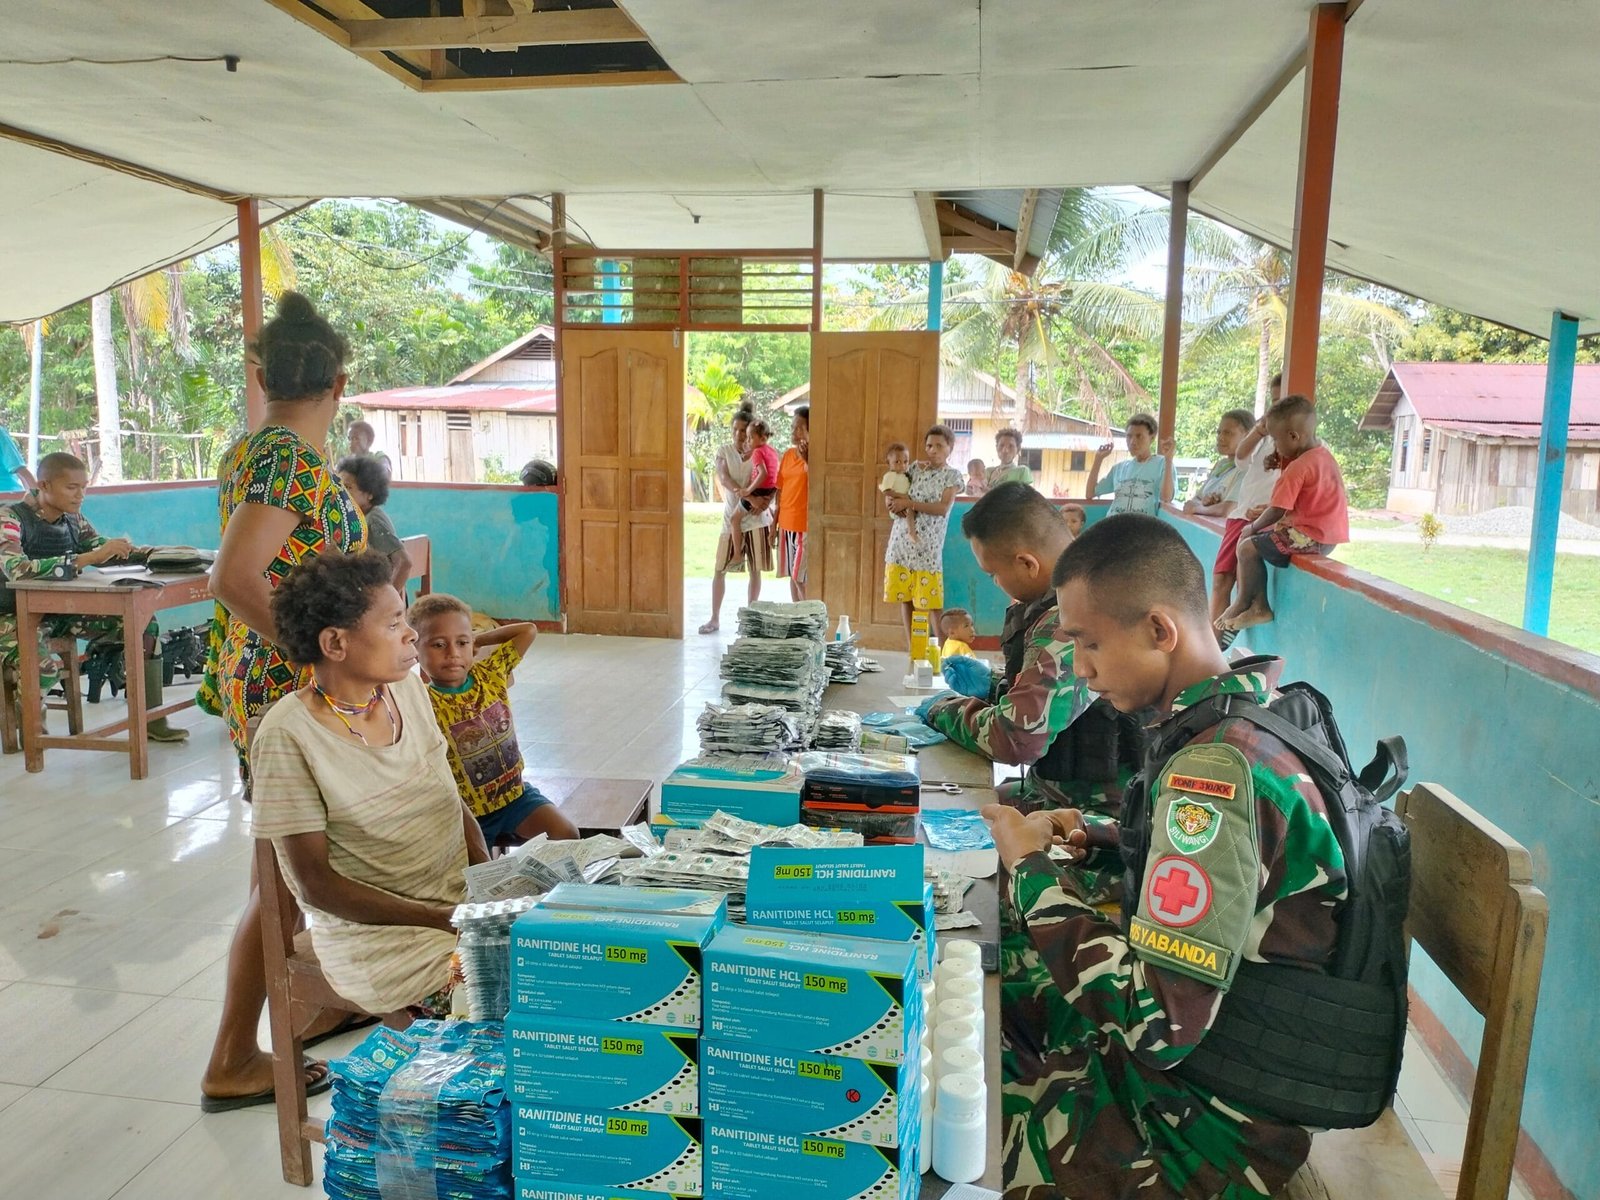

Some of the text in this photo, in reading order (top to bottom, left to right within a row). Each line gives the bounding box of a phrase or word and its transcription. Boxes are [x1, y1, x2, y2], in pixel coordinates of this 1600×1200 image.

[1170, 827, 1209, 845] SILIWANGI
[776, 866, 896, 878] RANITIDINE HCL 150 mg
[752, 910, 874, 923] RANITIDINE HCL 150 mg
[517, 938, 646, 963] RANITIDINE HCL 150 mg
[812, 946, 879, 960] RANITIDINE
[711, 962, 846, 992] RANITIDINE HCL 150 mg
[763, 979, 778, 987] SALUT
[779, 981, 800, 989] SELAPUT
[513, 1029, 642, 1054] RANITIDINE HCL 150 mg
[707, 1046, 841, 1080] RANITIDINE HCL 150 mg
[774, 1067, 795, 1075] SELAPUT
[519, 1108, 647, 1135] RANITIDINE HCL 150 mg
[711, 1126, 844, 1157] RANITIDINE HCL 150 mg
[522, 1189, 584, 1200] RANITIDINE
